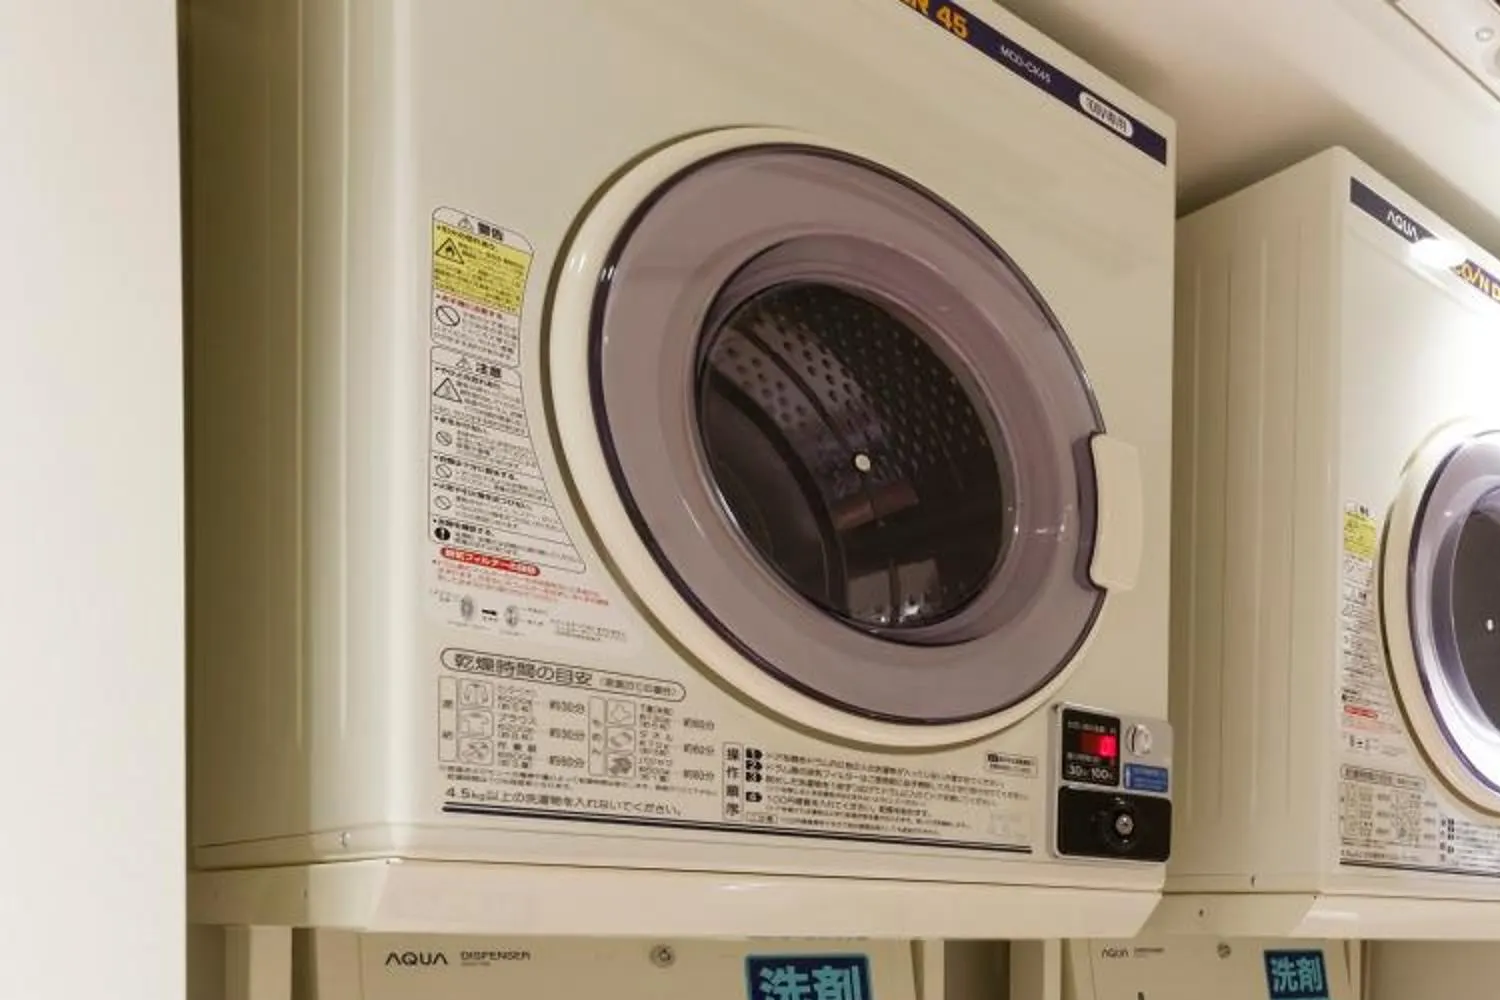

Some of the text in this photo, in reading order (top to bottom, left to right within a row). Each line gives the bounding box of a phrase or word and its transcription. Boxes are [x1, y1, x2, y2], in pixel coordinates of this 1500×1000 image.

[935, 5, 969, 39] 45
[384, 951, 531, 966] AQUA DISPENSER
[1269, 955, 1324, 993] 洗剤
